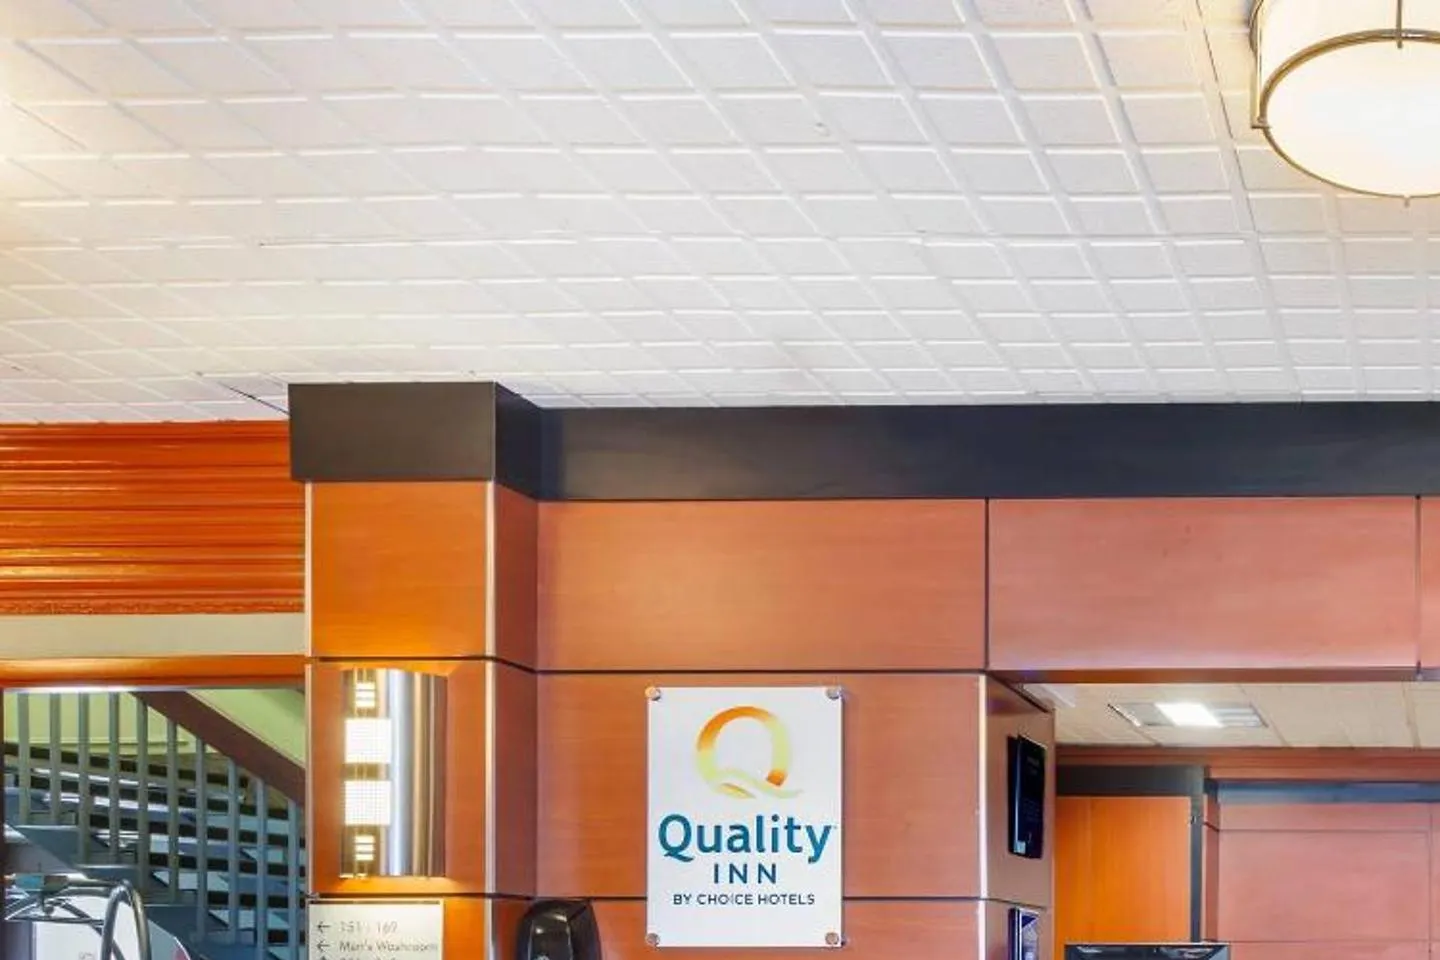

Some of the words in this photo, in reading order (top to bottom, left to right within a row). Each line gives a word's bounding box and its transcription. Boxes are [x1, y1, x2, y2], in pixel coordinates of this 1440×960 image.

[658, 813, 833, 865] Quality
[713, 863, 777, 885] INN
[673, 893, 692, 906] BY
[696, 893, 754, 906] CHOICE
[757, 893, 816, 906] HOTELS
